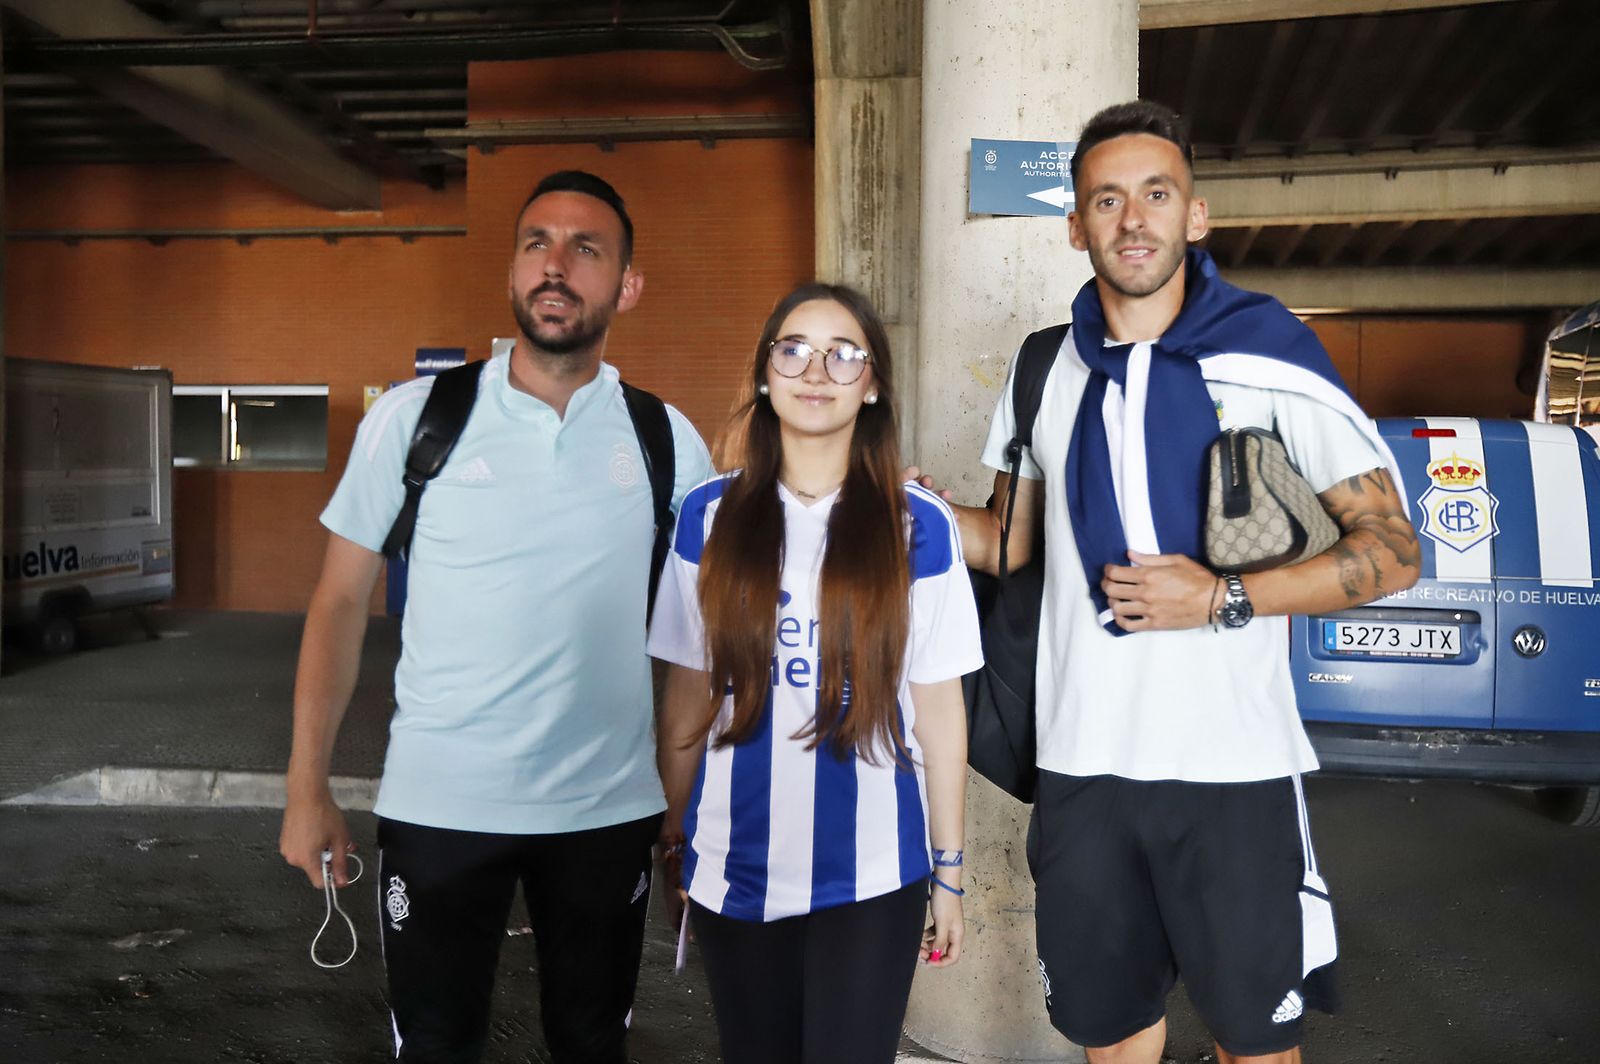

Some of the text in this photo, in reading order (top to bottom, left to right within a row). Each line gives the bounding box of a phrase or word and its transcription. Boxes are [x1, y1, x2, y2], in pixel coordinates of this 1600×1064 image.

[1020, 161, 1071, 170] AUTORI
[81, 549, 140, 569] Información
[1412, 587, 1515, 604] RECREATIVO
[1520, 590, 1541, 605] DE
[1341, 626, 1401, 647] 5273
[1410, 629, 1453, 650] JTX
